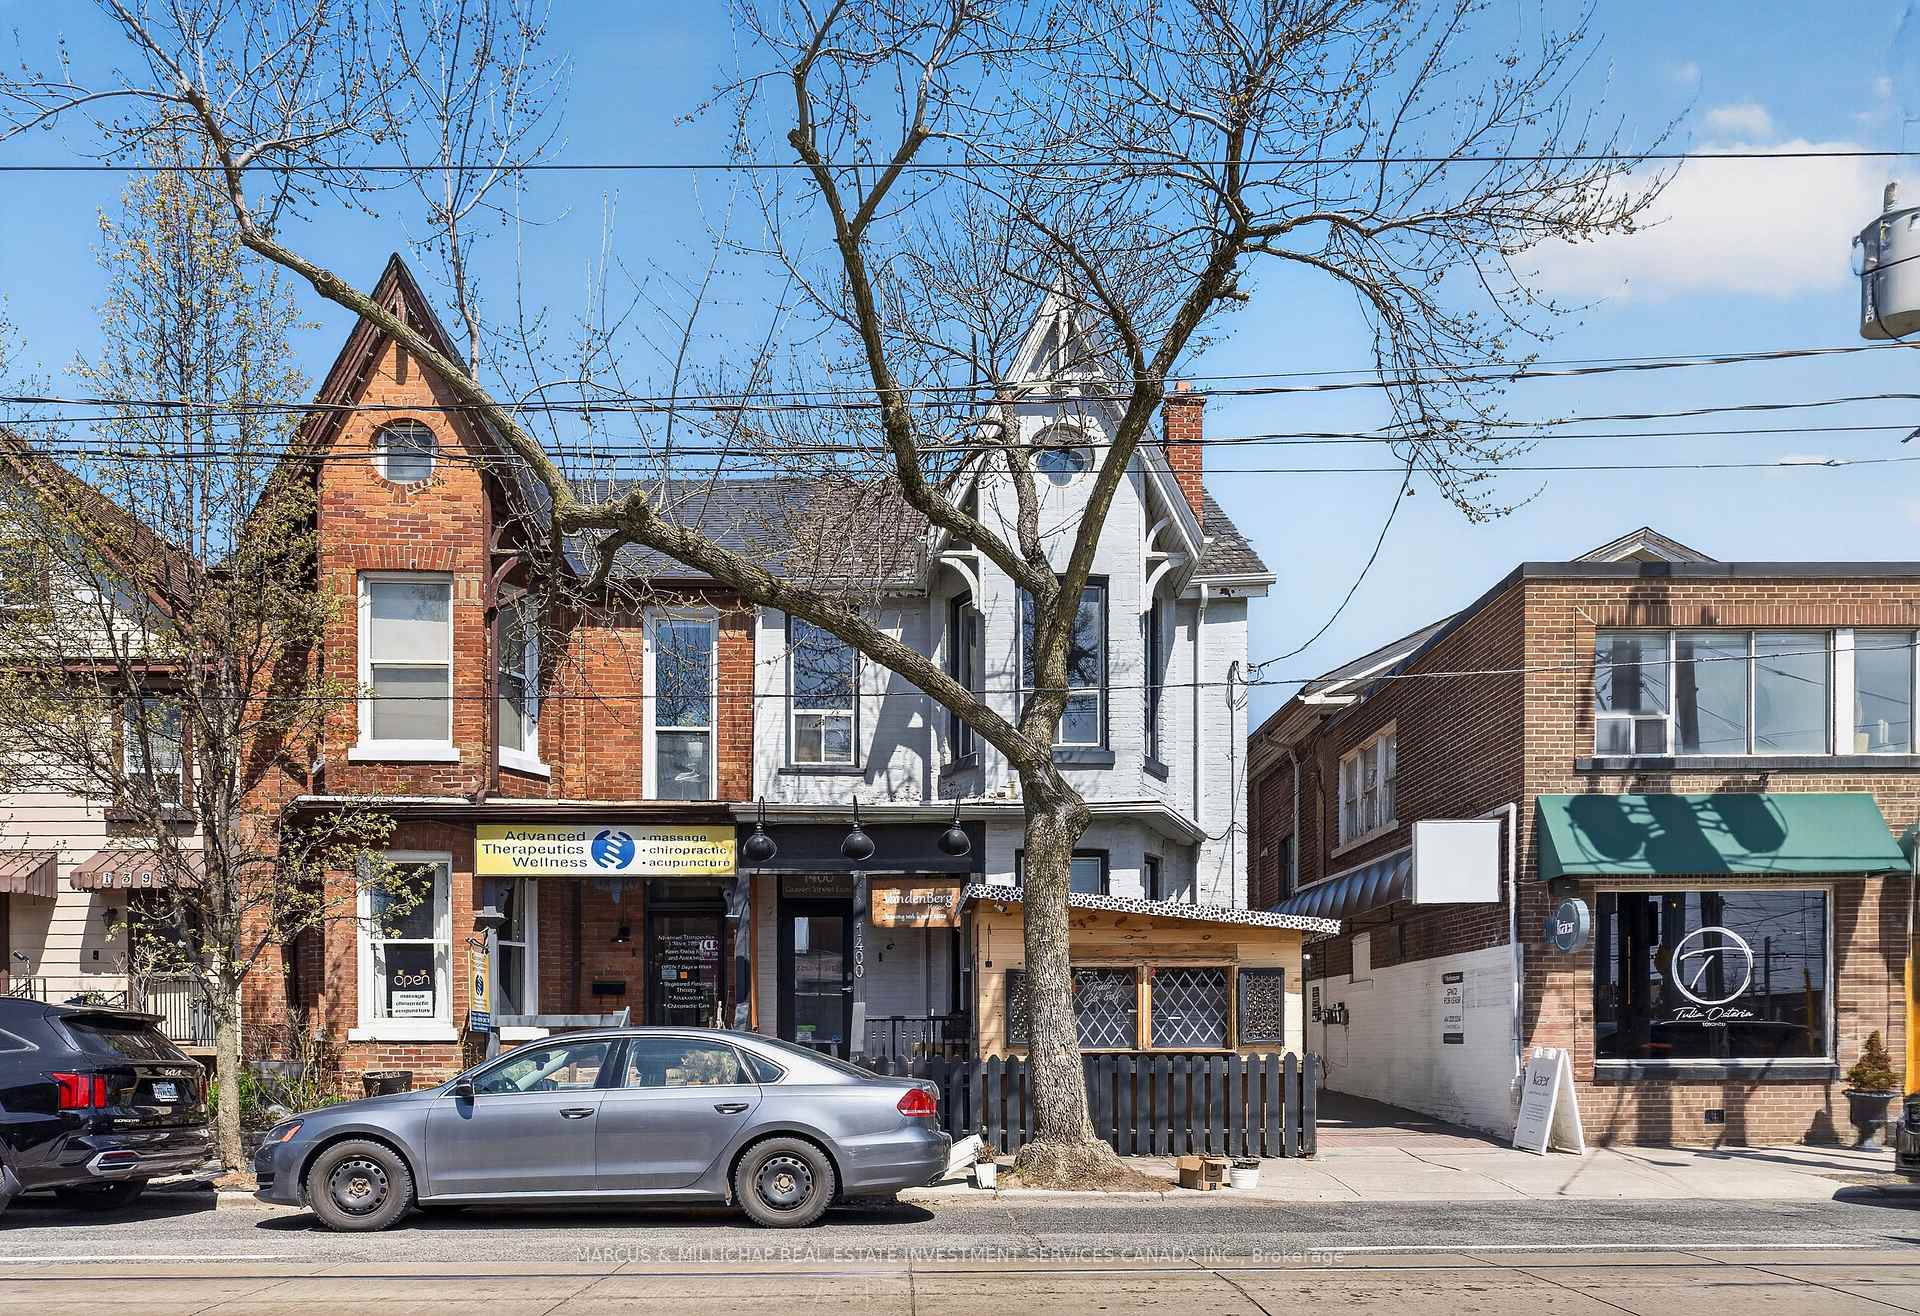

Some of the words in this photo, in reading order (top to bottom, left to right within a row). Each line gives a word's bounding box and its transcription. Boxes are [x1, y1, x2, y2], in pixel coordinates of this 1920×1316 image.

[504, 830, 586, 842] Advanced
[649, 834, 707, 844] massage
[482, 843, 585, 856] Therapeutics
[649, 845, 727, 856] chiropractic
[512, 856, 588, 868] Wellness
[649, 858, 731, 868] acupuncture
[393, 975, 431, 988] open
